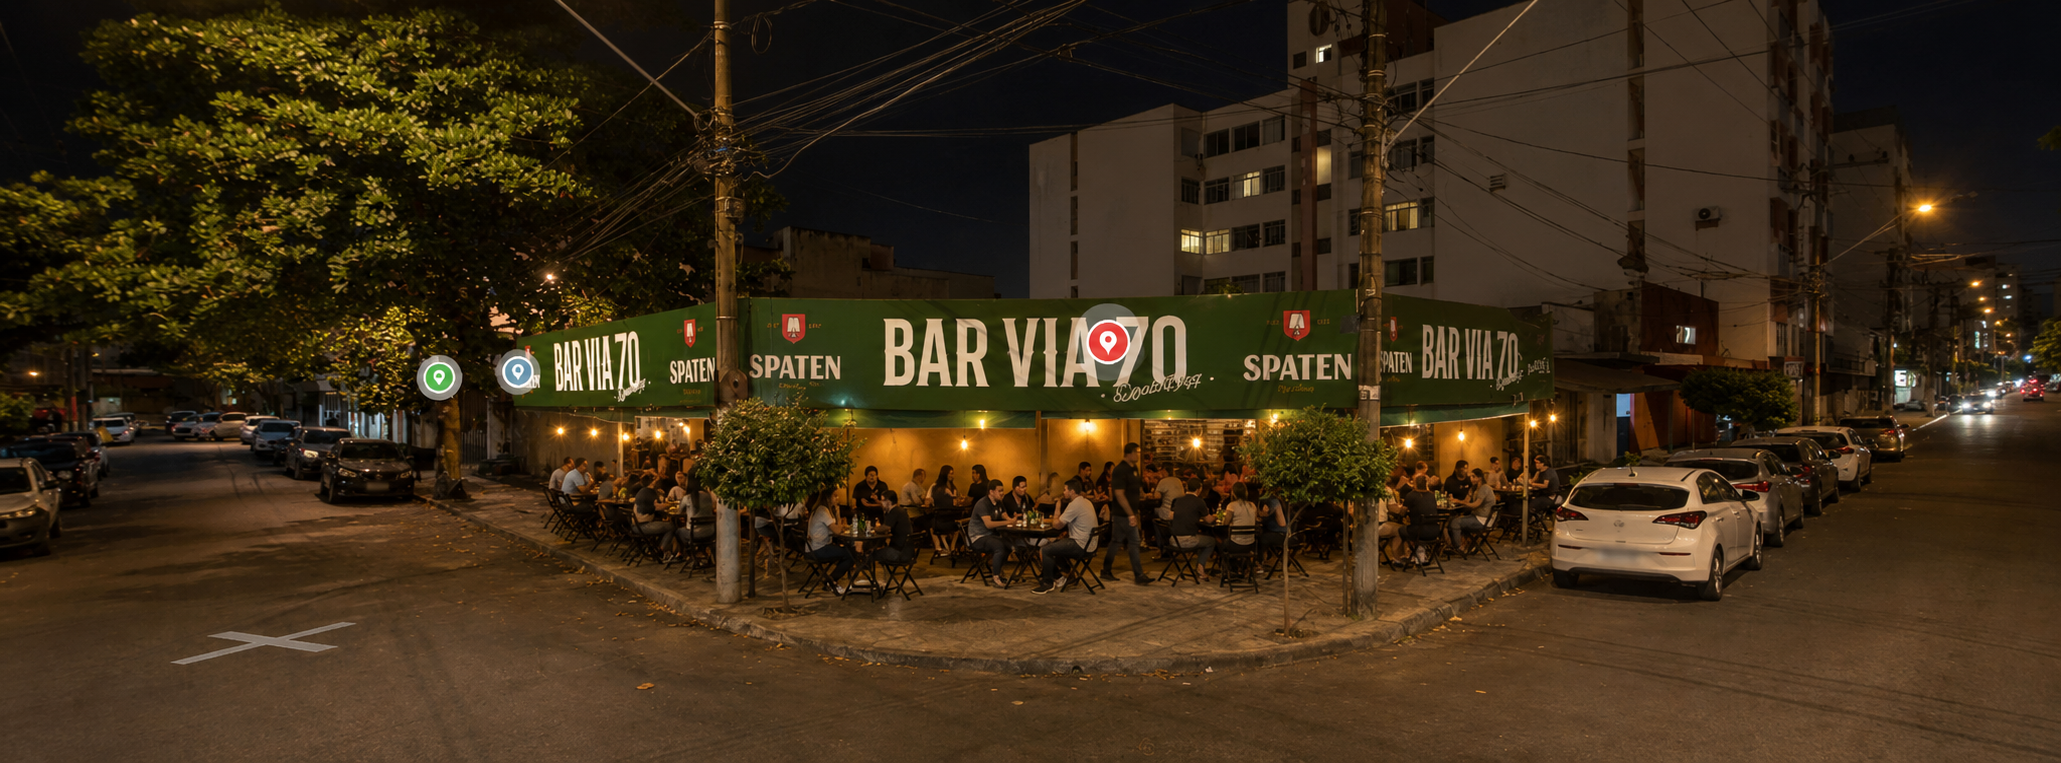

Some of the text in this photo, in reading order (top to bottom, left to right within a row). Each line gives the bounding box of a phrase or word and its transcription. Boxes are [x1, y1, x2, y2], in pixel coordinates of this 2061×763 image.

[553, 340, 584, 391] BAR
[584, 335, 614, 390] VIA
[614, 331, 641, 390] 70
[670, 357, 716, 384] SPATEN
[749, 354, 841, 380] SPATEN
[883, 315, 1187, 387] BAR VIA 70
[1243, 353, 1352, 381] SPATEN
[1422, 324, 1460, 380] BAR
[1465, 328, 1494, 380] VIA
[1497, 331, 1519, 380] 70
